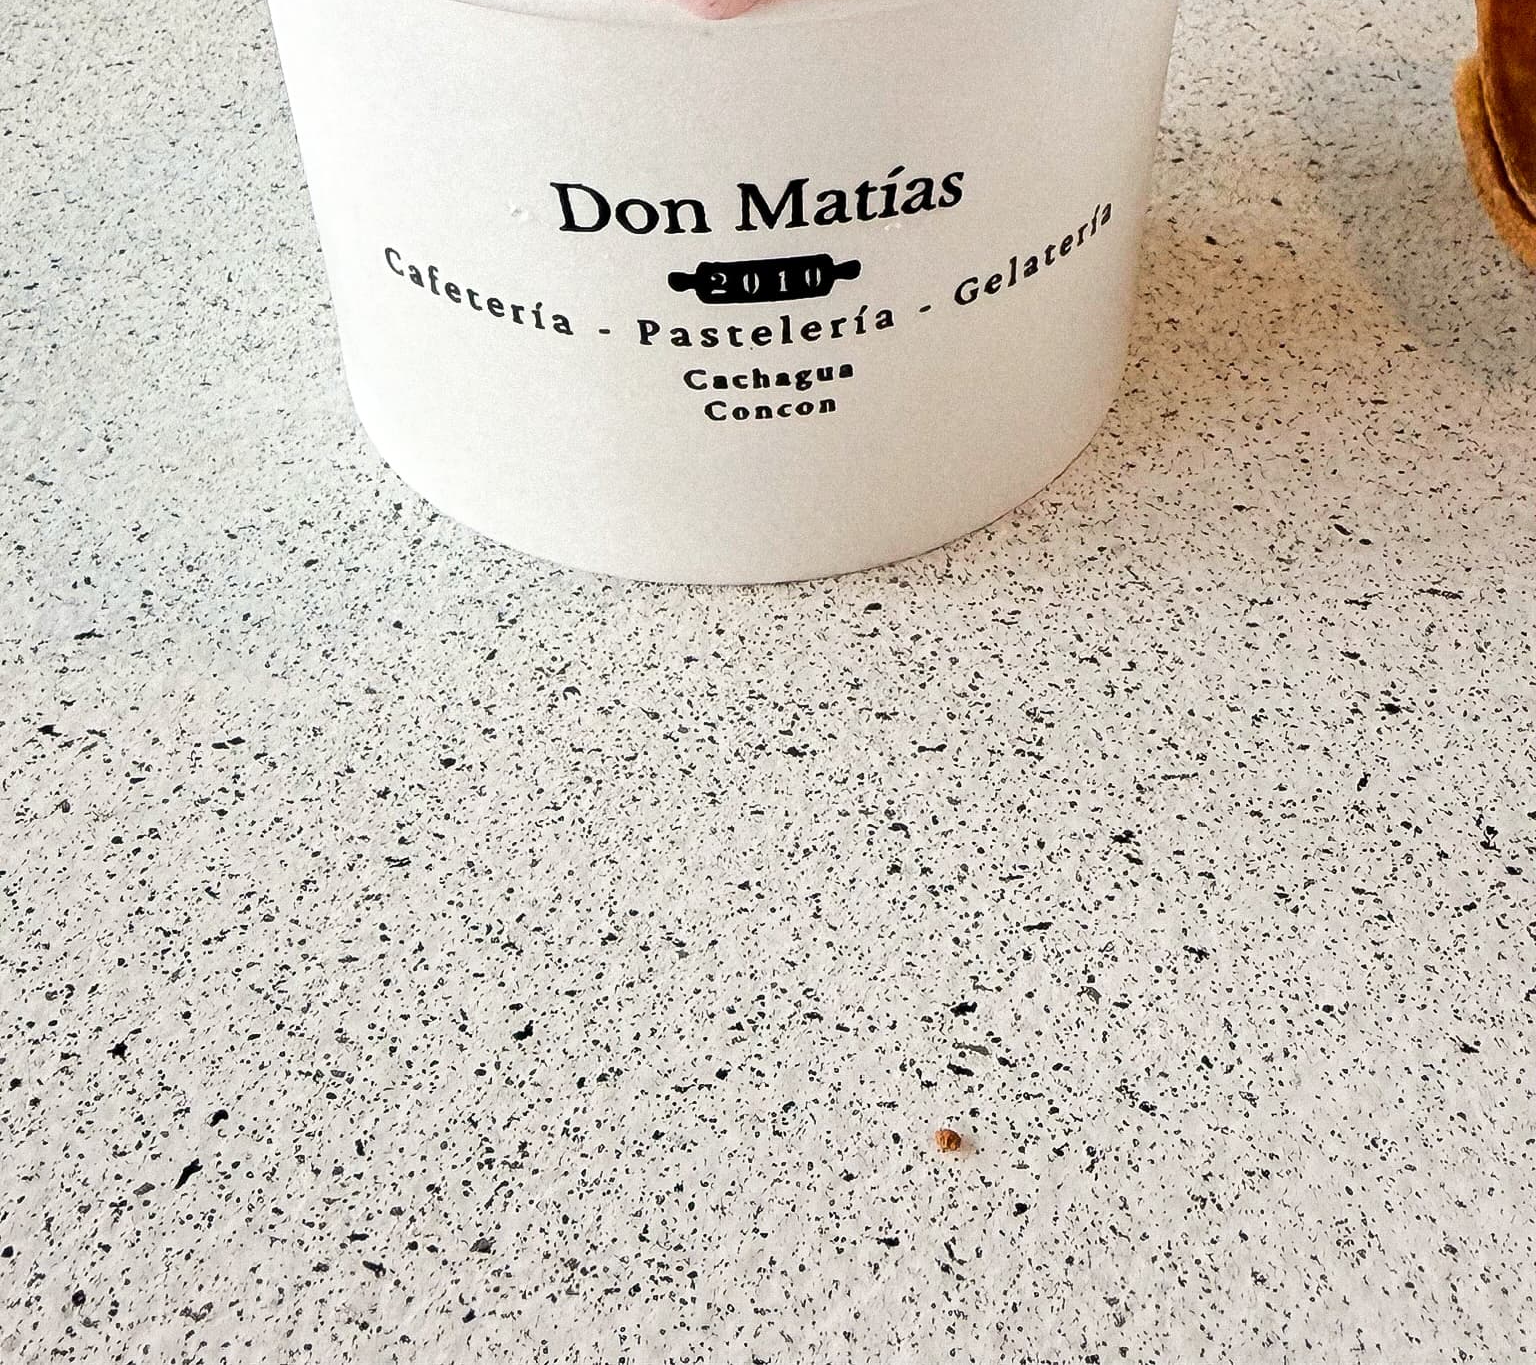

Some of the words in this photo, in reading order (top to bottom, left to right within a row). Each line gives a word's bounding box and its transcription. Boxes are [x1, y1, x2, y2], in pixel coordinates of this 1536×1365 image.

[550, 181, 713, 234] Don
[734, 165, 965, 232] Matías
[384, 247, 574, 336] Cafetería
[636, 304, 895, 348] Pastelería
[953, 202, 1113, 307] Gelatería
[711, 266, 821, 295] 2010
[683, 363, 854, 392] Cachagua
[703, 398, 837, 421] Concon
